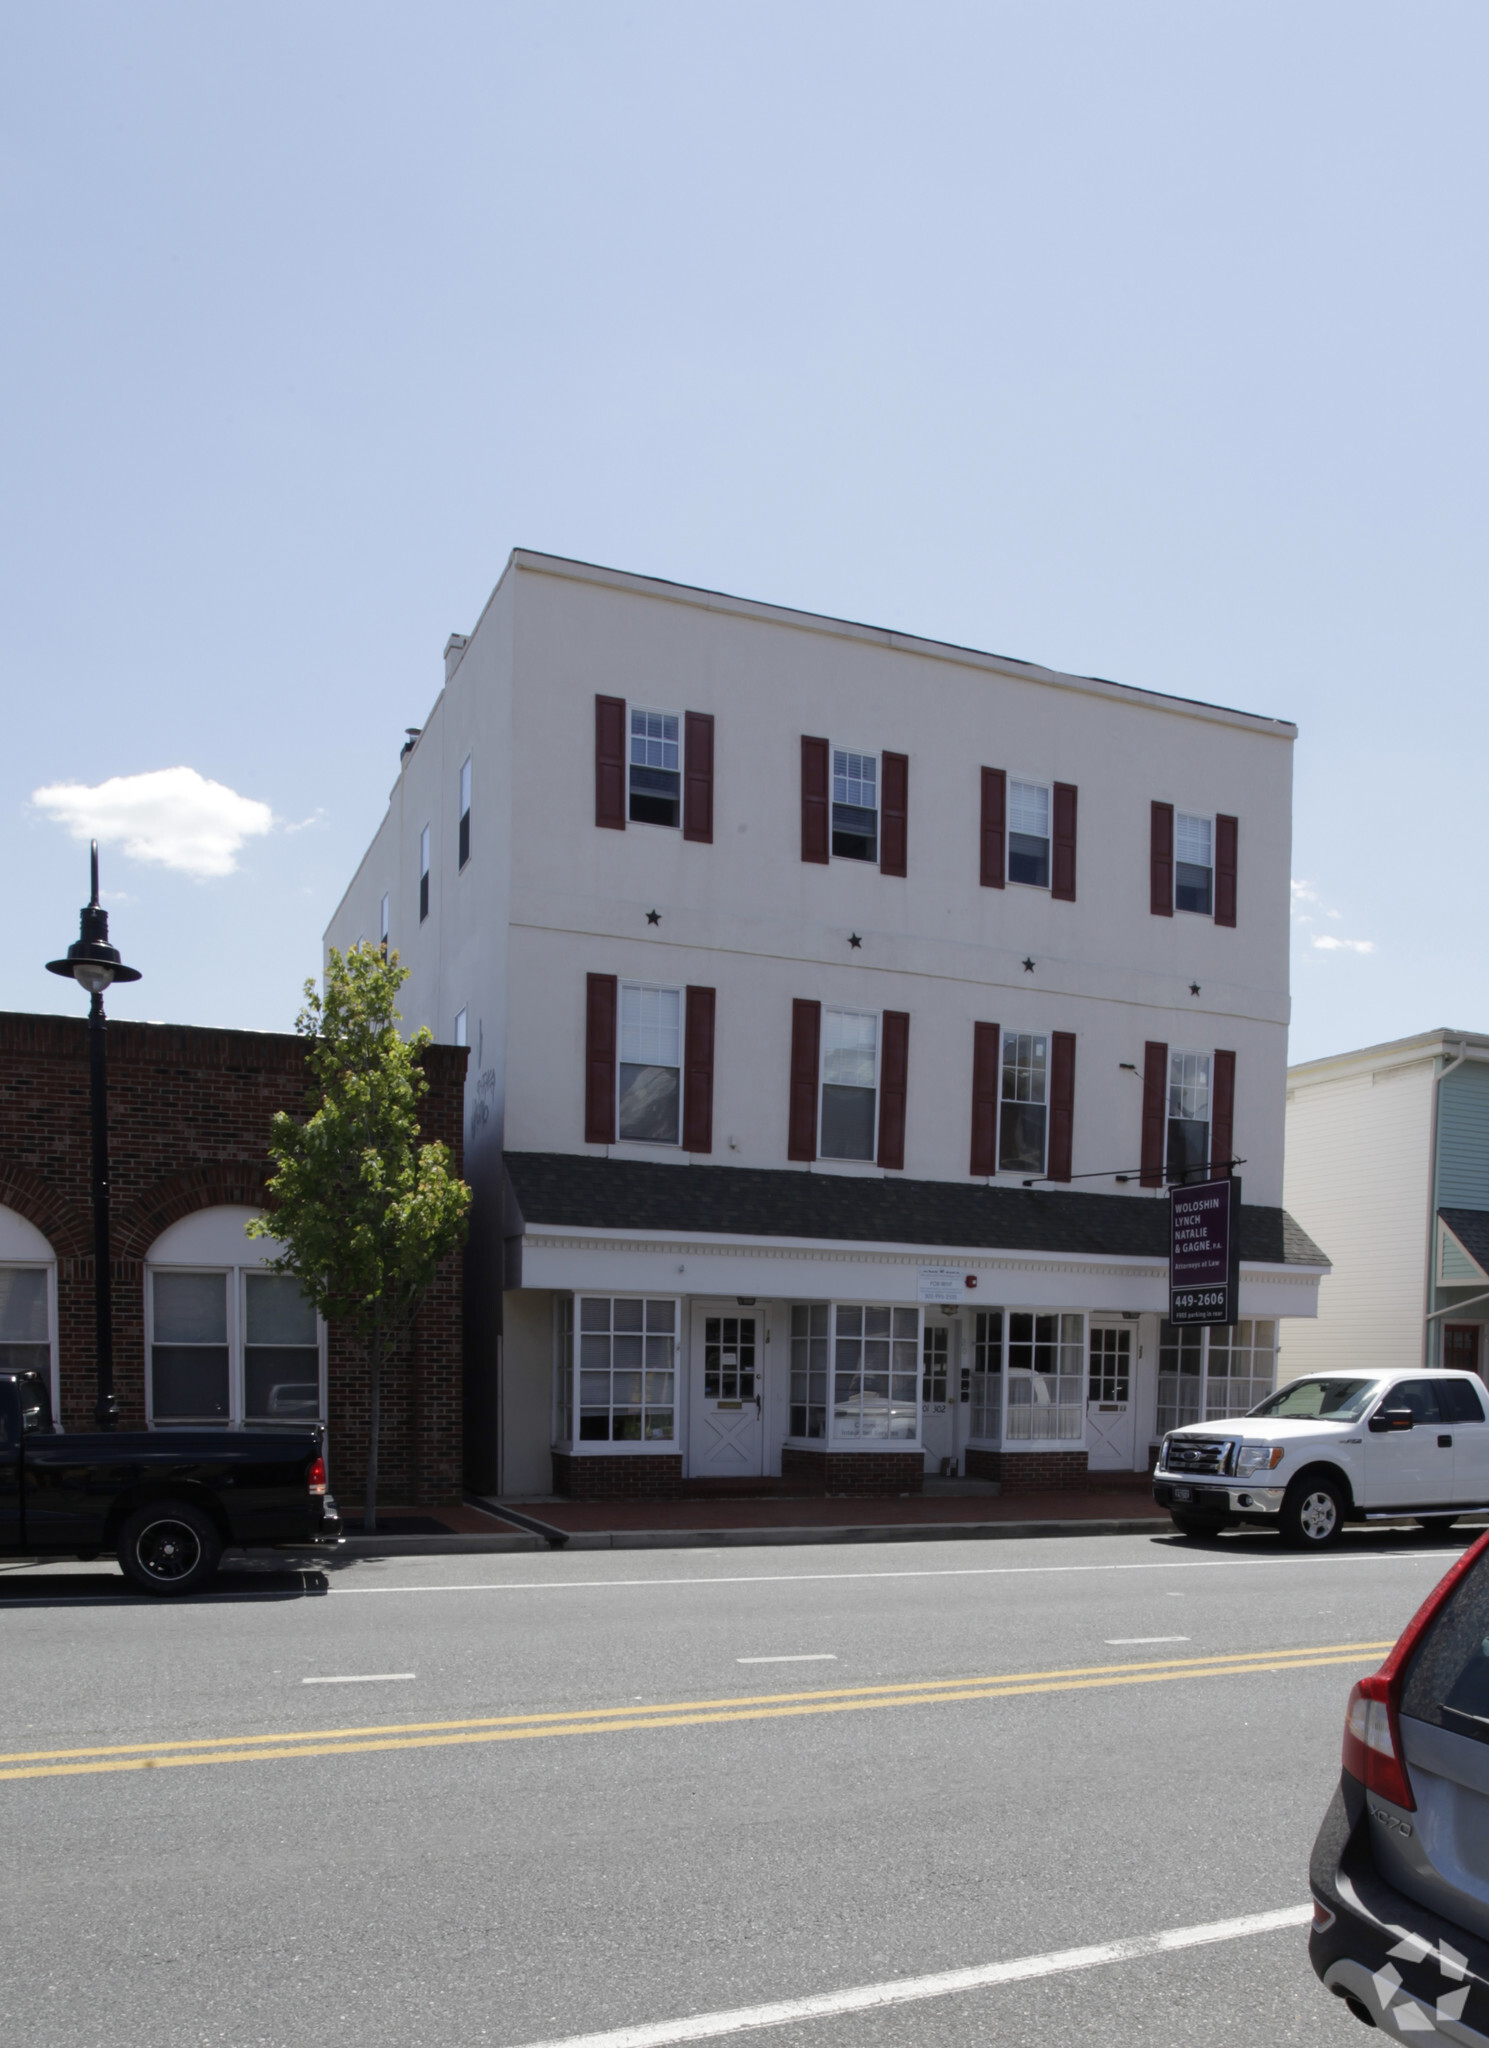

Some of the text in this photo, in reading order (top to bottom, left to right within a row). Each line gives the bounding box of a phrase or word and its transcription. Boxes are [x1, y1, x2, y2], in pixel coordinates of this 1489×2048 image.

[1174, 1199, 1219, 1213] WOLOSHIN
[1174, 1214, 1201, 1227] LYNCH
[1174, 1226, 1208, 1241] NATALIE
[1174, 1243, 1181, 1254] &
[1174, 1259, 1220, 1271] Attorneys at Law
[1175, 1291, 1224, 1307] 449-2606
[1175, 1311, 1187, 1319] FREE
[1187, 1311, 1206, 1320] parking
[1371, 1803, 1412, 1838] XC70
